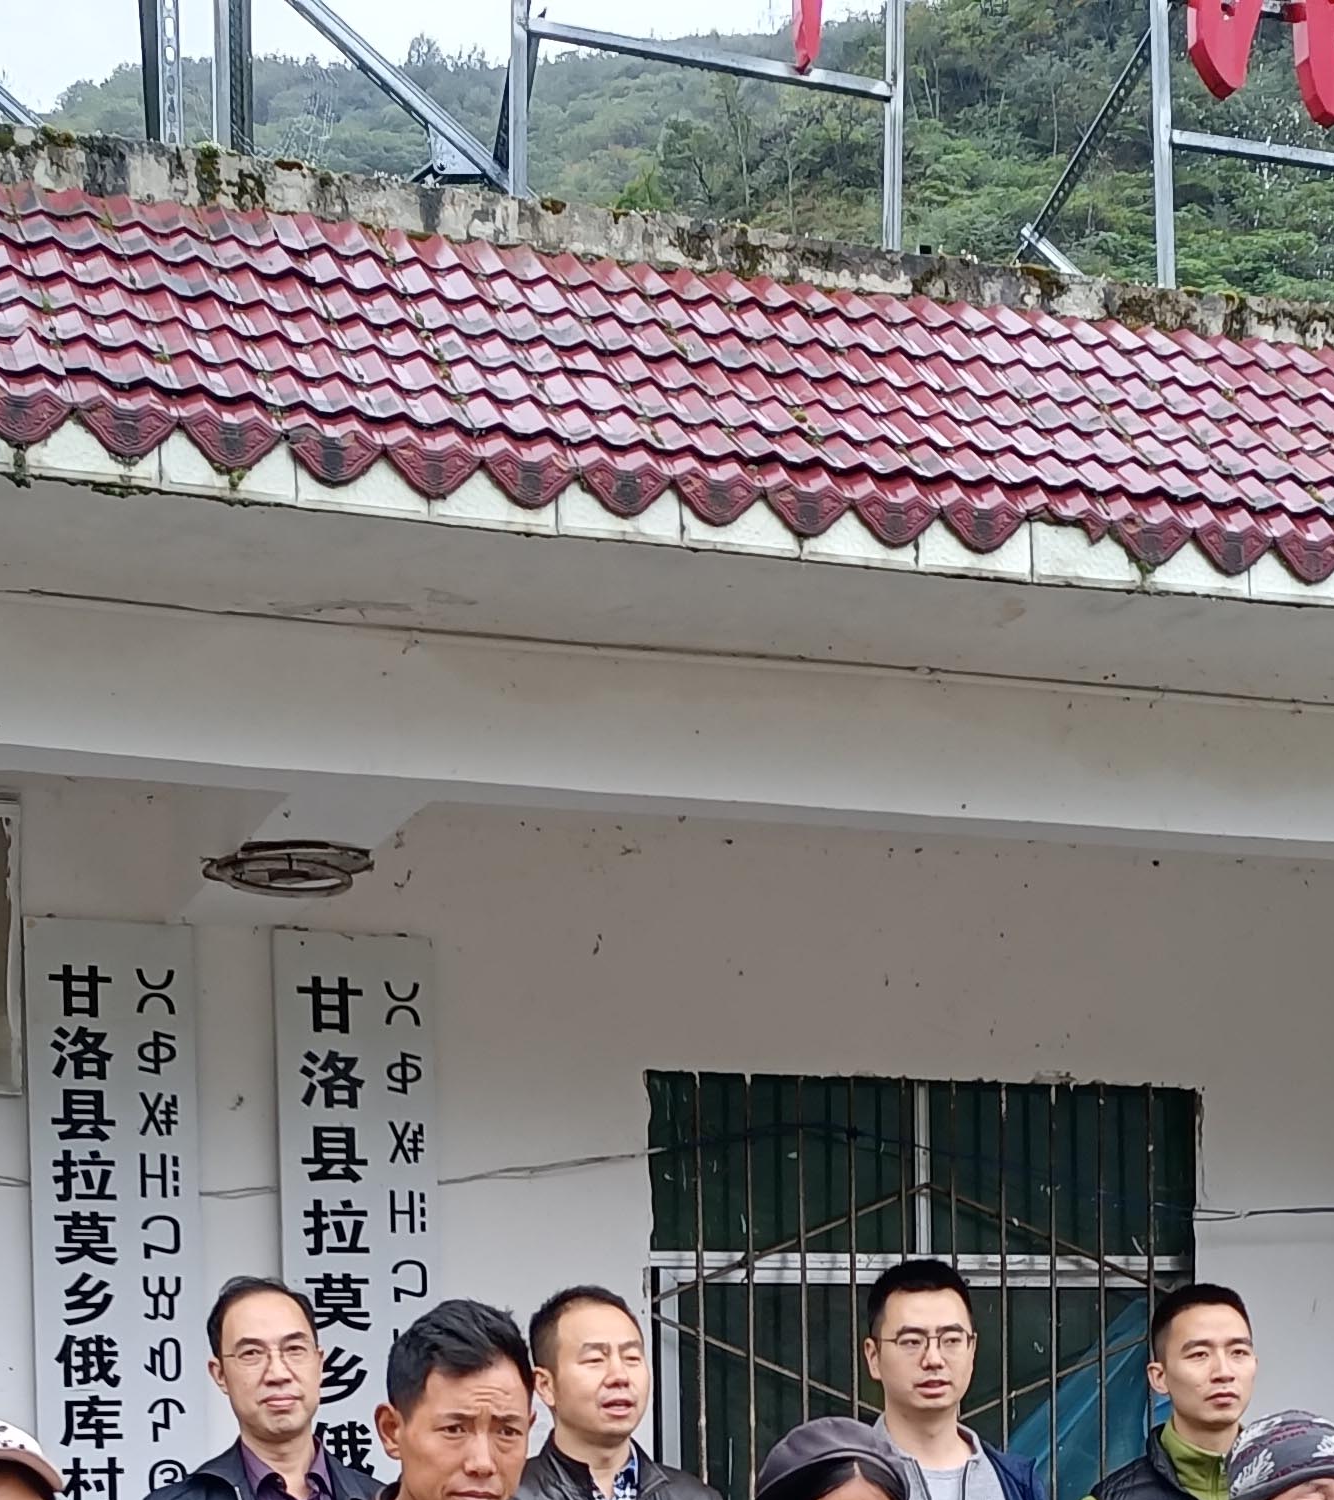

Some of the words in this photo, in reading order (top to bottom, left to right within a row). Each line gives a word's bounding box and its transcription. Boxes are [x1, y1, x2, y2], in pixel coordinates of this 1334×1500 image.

[296, 975, 373, 1478] 甘洛县拉莫乡俄
